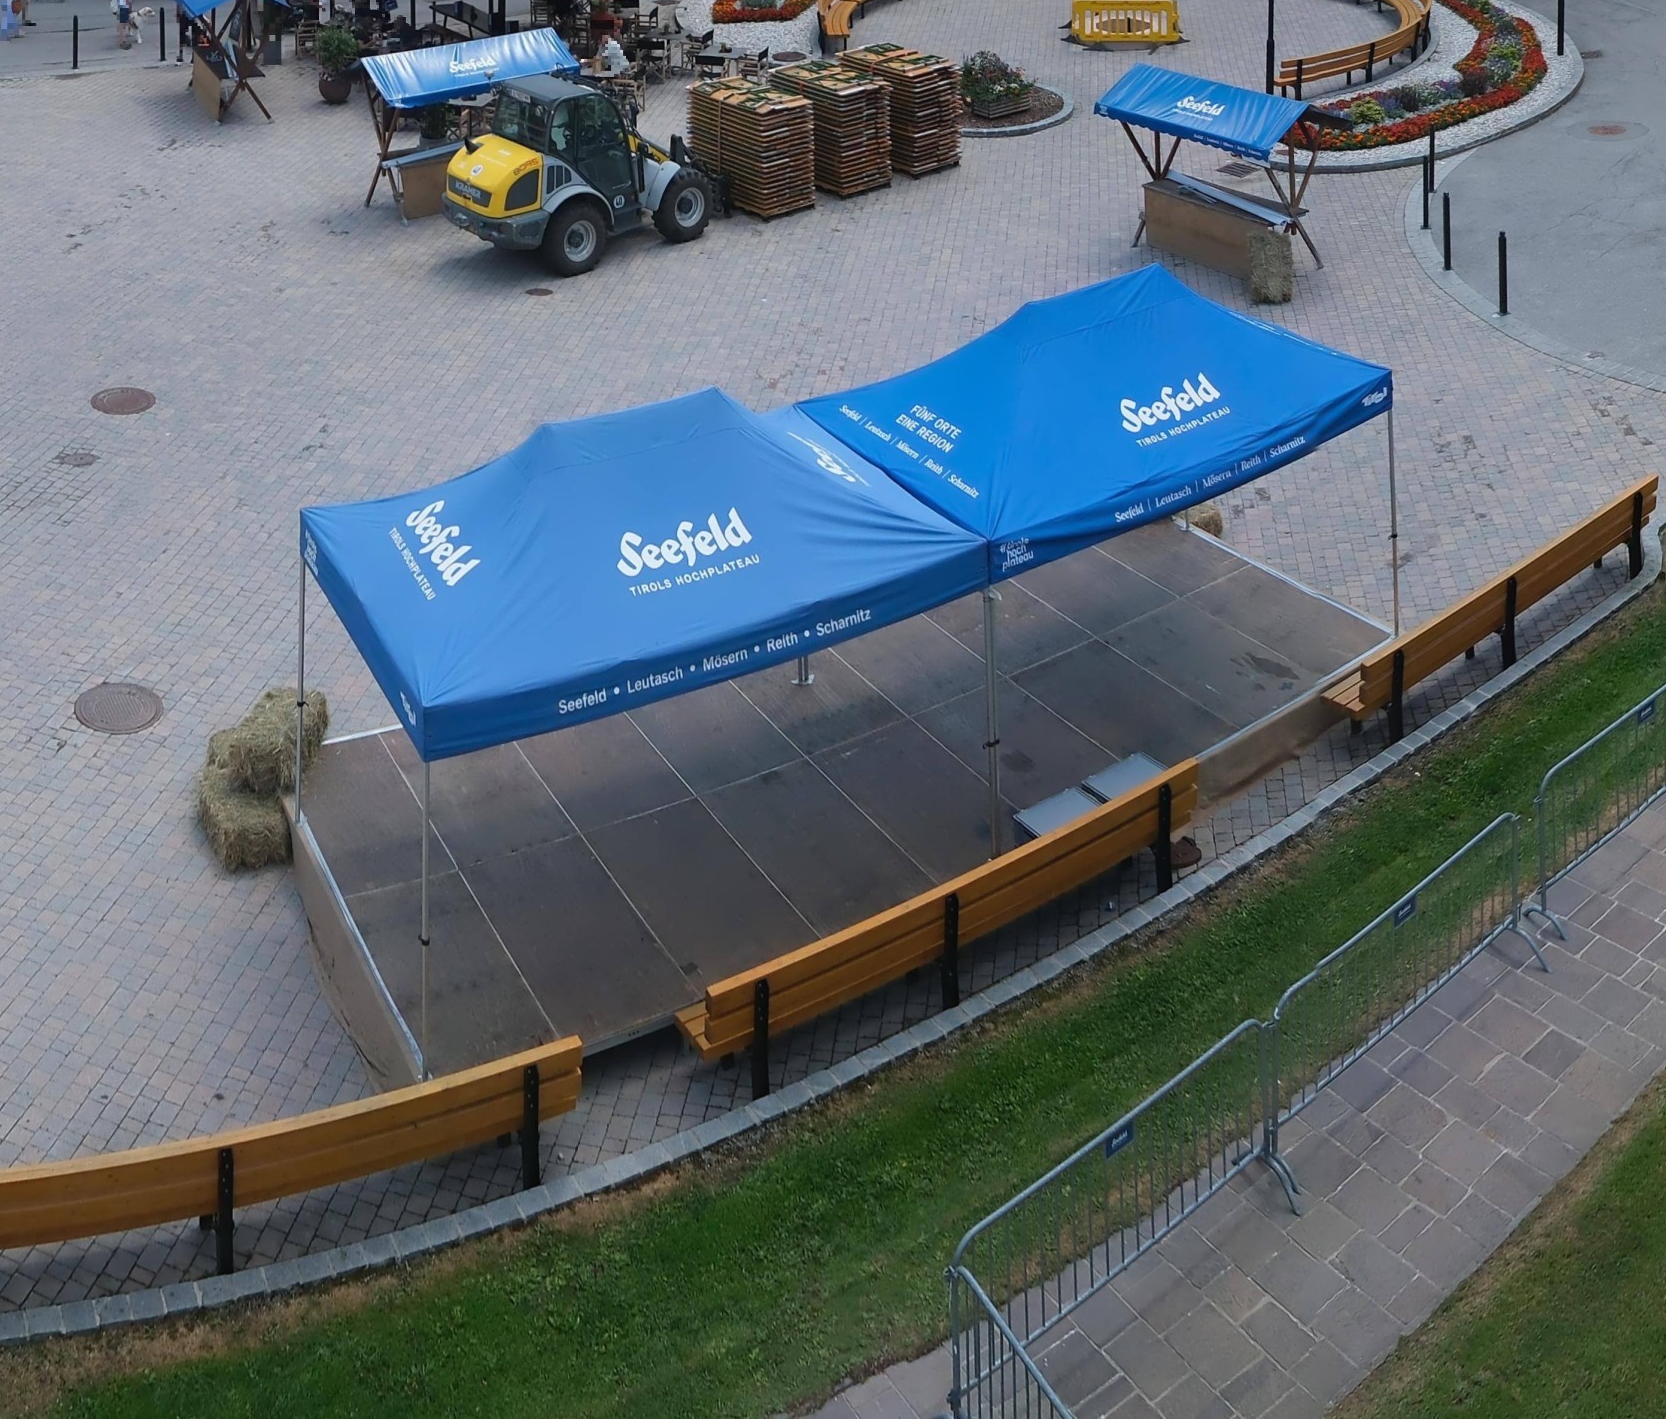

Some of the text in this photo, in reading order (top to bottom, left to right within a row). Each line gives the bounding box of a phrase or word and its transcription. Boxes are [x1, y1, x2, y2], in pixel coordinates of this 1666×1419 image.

[449, 56, 497, 74] Seefeld
[1176, 95, 1227, 117] Seefeld
[909, 405, 962, 440] FÜNF ORTE
[1119, 371, 1221, 434] Seefeld
[1135, 405, 1231, 449] TIROLS HOCHPLATEAU
[839, 404, 980, 499] Seefeld Leutasch Mösern Reith Scharnitz
[895, 414, 955, 454] EINE REGION
[1114, 434, 1306, 524] Seefeld Leutasch Mösern Reith Scharnitz
[388, 526, 437, 602] TIROLS HOCHPLATEAU
[405, 499, 481, 587] Seefeld
[616, 506, 753, 578] Seefeld
[1002, 549, 1034, 573] plateau
[629, 553, 761, 597] TIROLS HOCHPLATEAU
[558, 607, 872, 715] Seefeld Leutasch Mösern Reith Scharnitz
